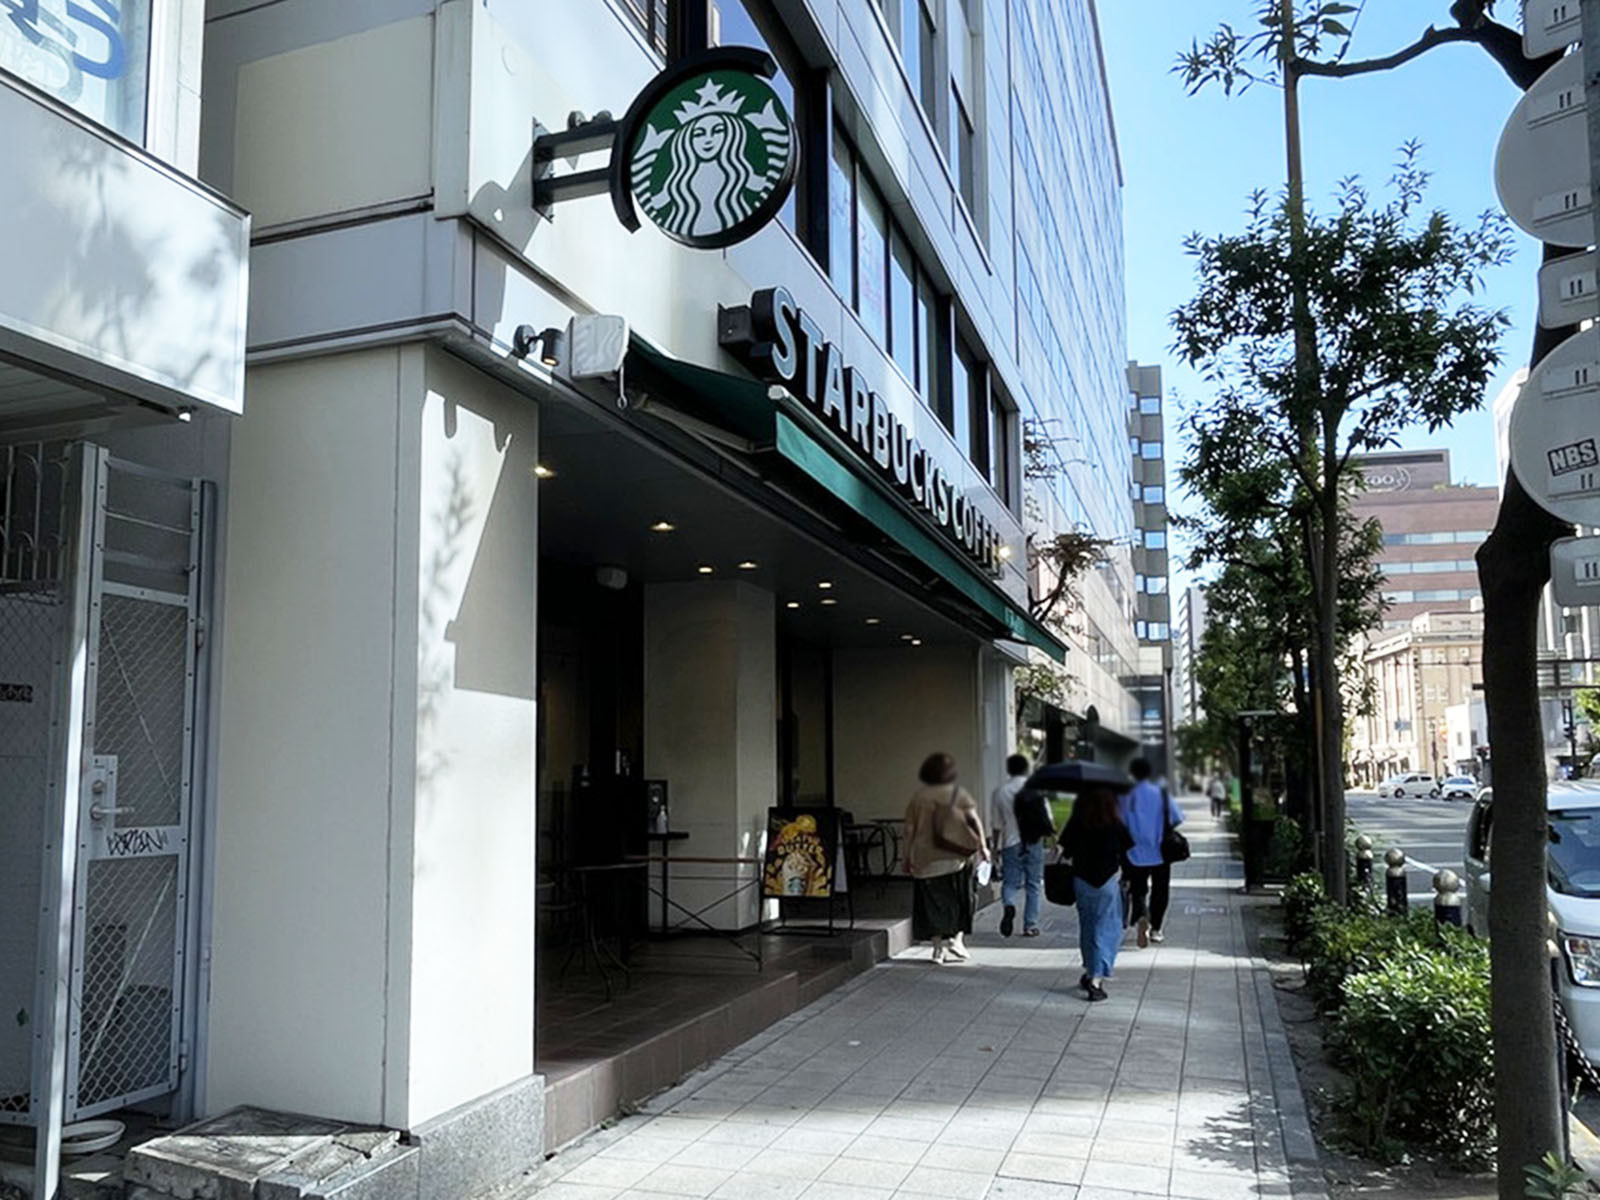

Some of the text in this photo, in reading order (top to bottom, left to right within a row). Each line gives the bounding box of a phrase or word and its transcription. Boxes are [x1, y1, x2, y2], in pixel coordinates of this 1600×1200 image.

[768, 285, 1004, 579] STARBUCKS COFFE
[1549, 441, 1596, 470] NBS
